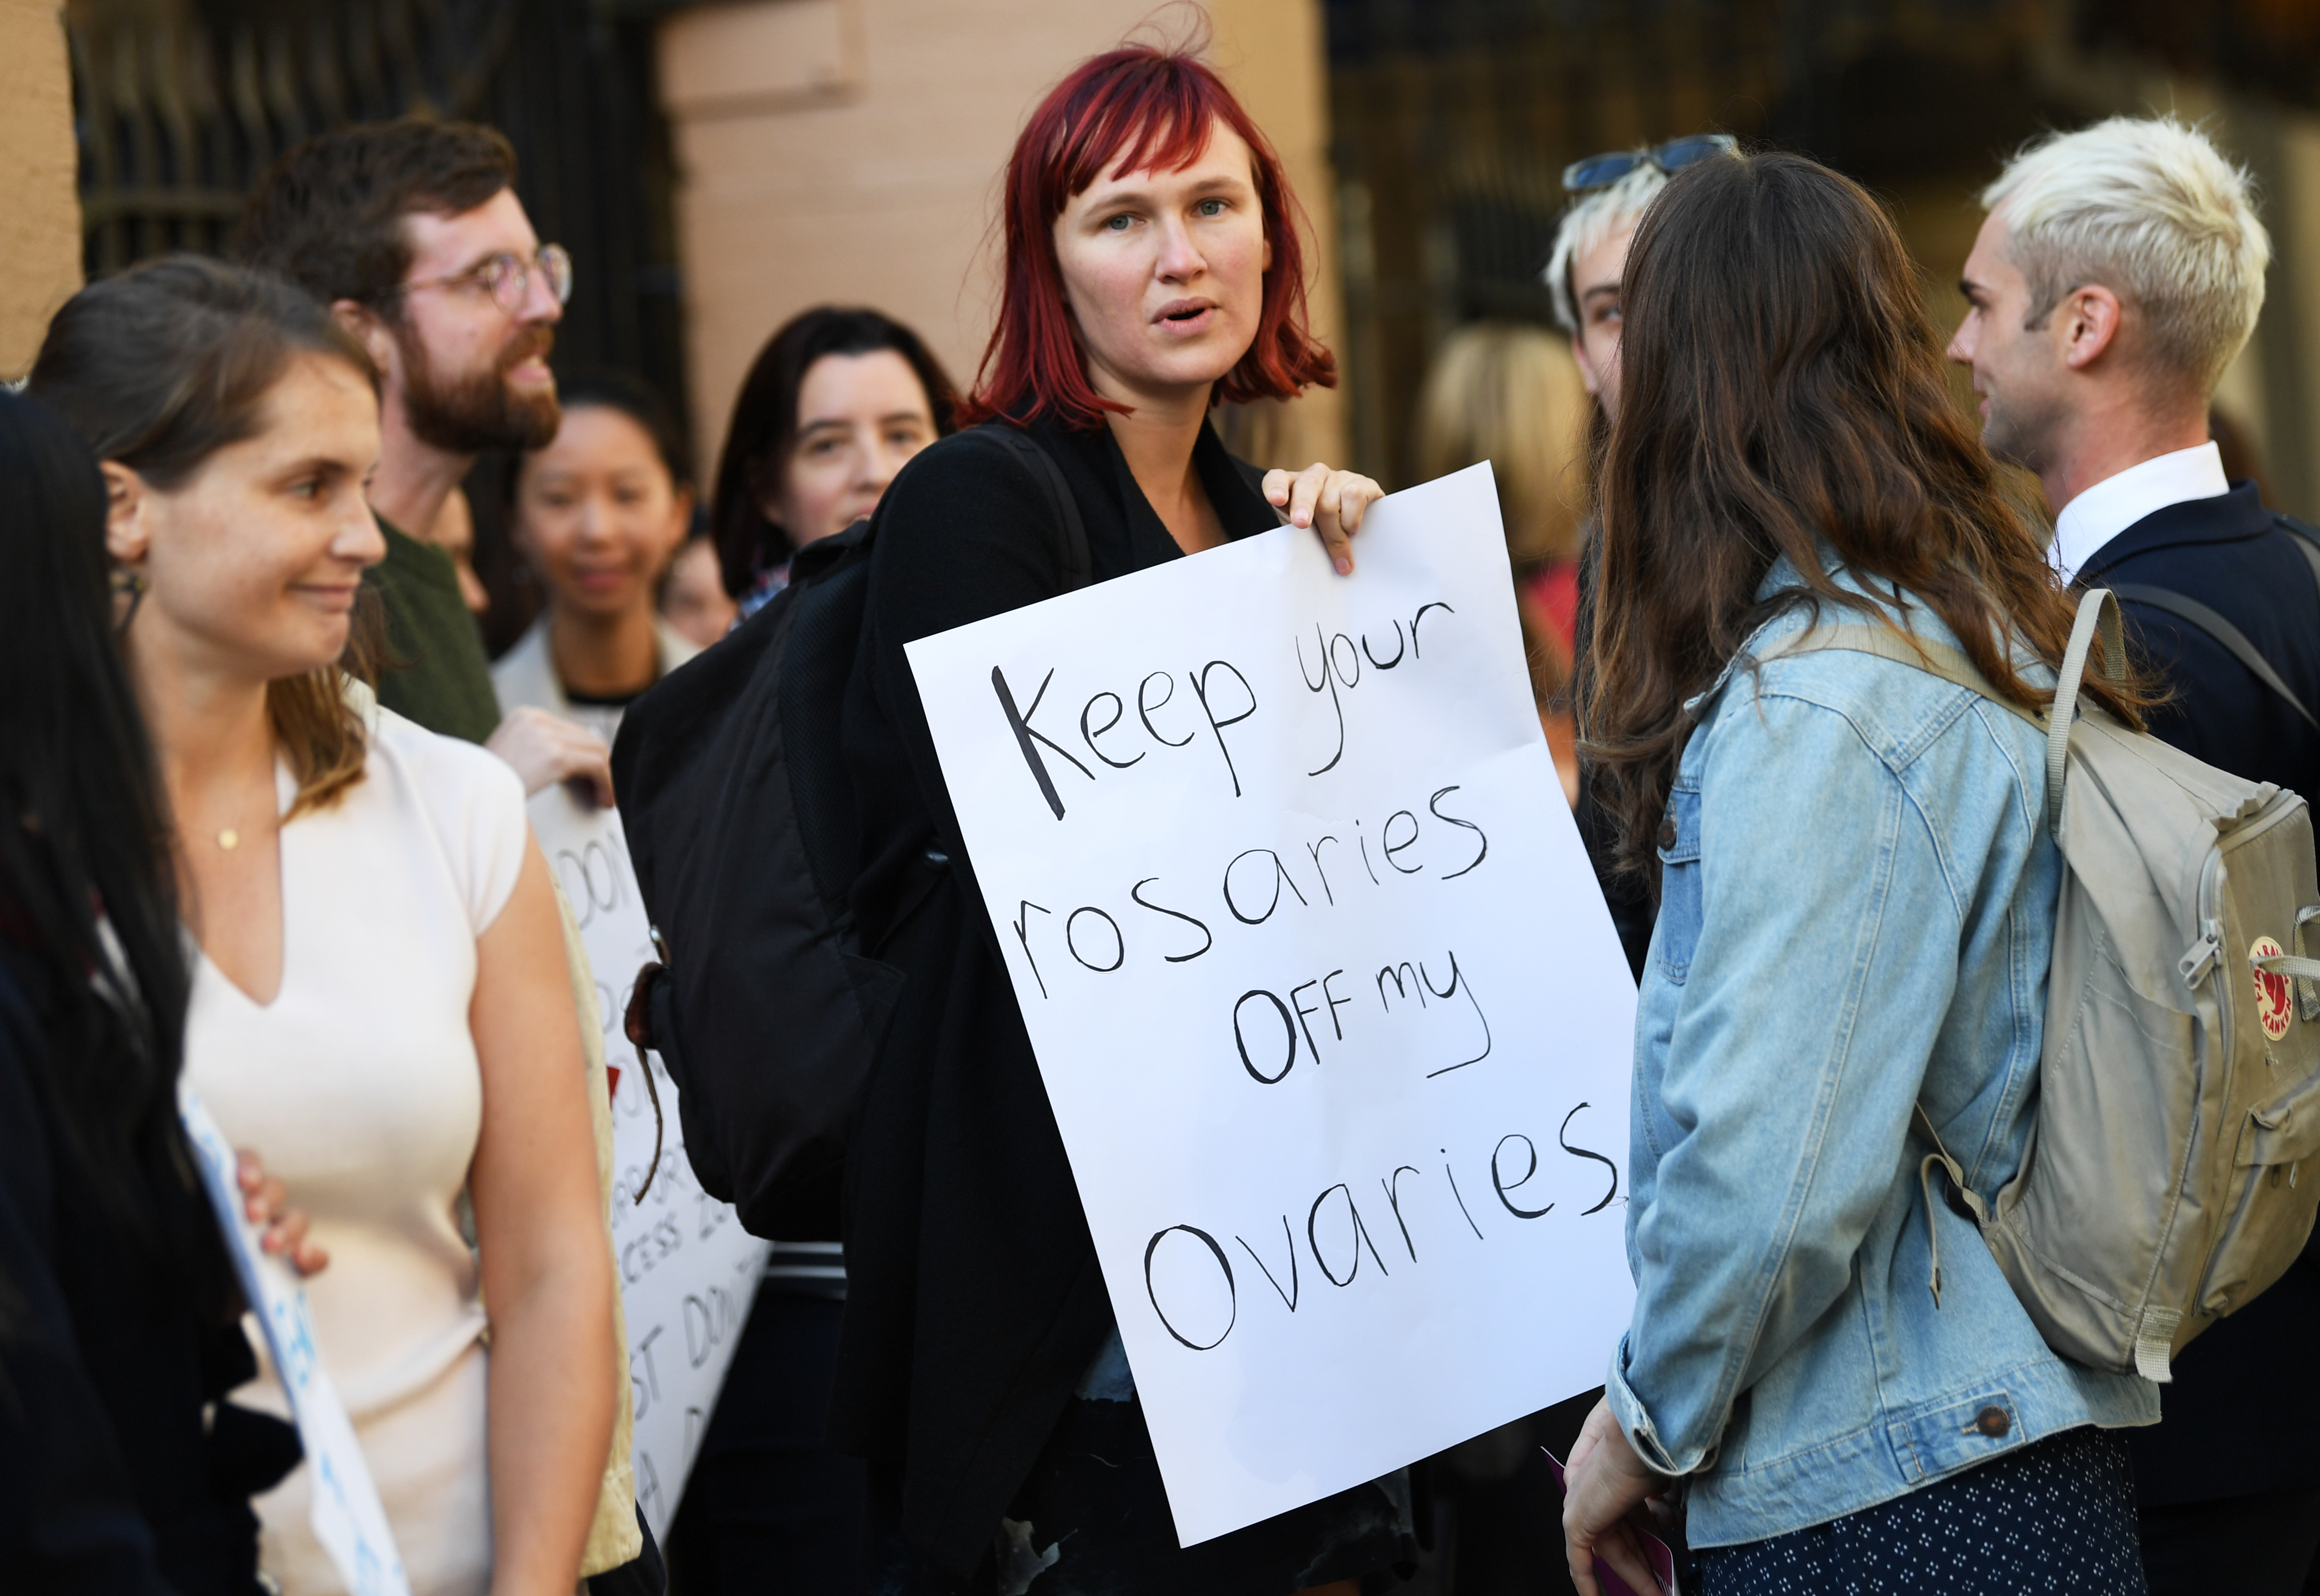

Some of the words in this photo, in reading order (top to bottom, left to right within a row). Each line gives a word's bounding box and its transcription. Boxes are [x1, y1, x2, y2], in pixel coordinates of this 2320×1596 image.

[991, 661, 1256, 821] Keep
[1295, 602, 1455, 777] your
[1013, 786, 1487, 1000] rosaries
[1376, 950, 1491, 1079] my
[1144, 1102, 1617, 1351] Ovaries
